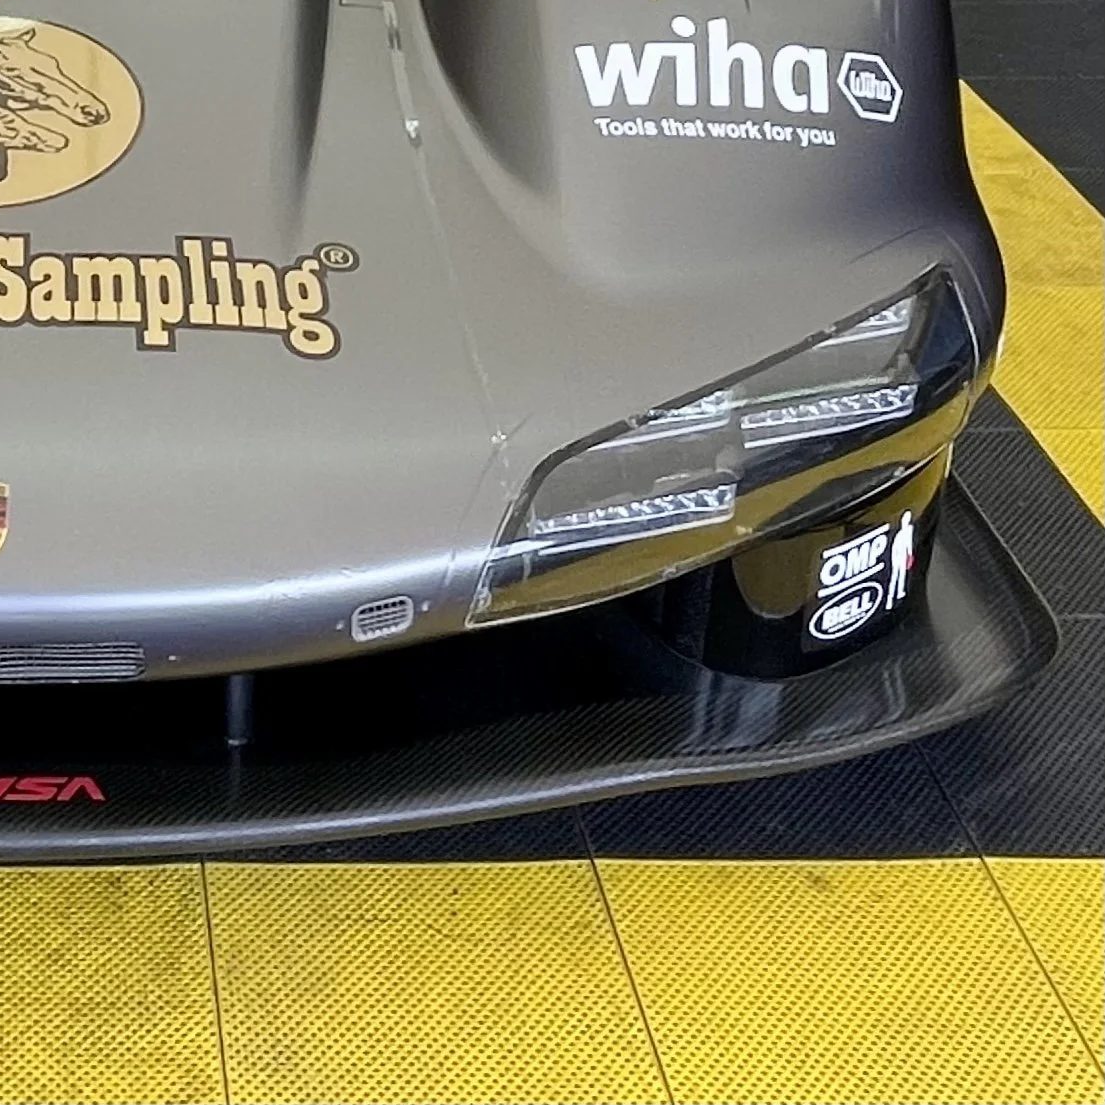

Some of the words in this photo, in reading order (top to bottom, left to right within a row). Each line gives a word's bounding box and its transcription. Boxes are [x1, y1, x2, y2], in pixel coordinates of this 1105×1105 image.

[575, 15, 830, 114] wiha
[594, 117, 657, 136] Tools
[660, 118, 706, 138] that
[707, 120, 762, 140] work
[762, 121, 794, 142] for
[795, 127, 836, 147] you
[820, 534, 888, 586] OMP
[821, 591, 874, 631] BELL
